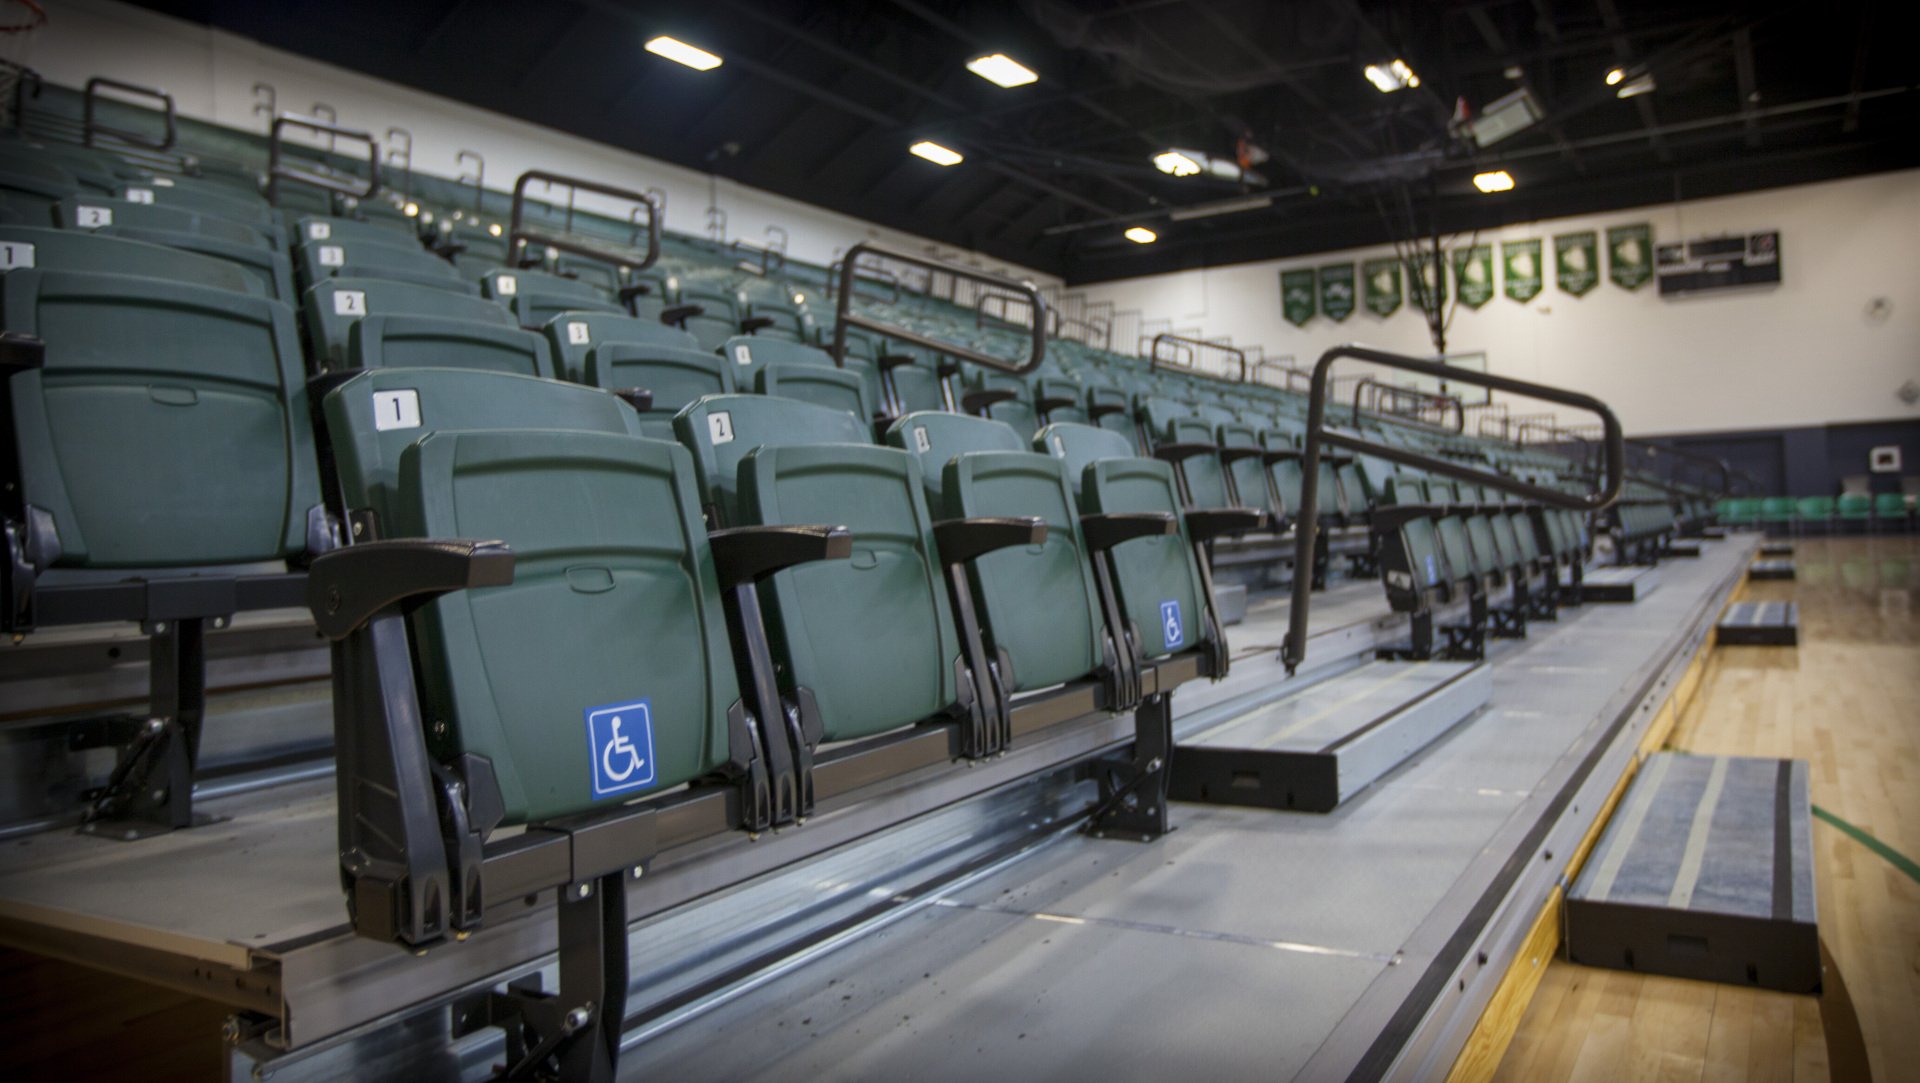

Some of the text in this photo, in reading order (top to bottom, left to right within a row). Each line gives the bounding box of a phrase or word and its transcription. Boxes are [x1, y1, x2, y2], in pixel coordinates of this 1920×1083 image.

[92, 211, 100, 224] 2
[5, 246, 13, 264] 1
[345, 295, 355, 310] 2
[392, 397, 401, 422] 1
[716, 418, 725, 437] 2
